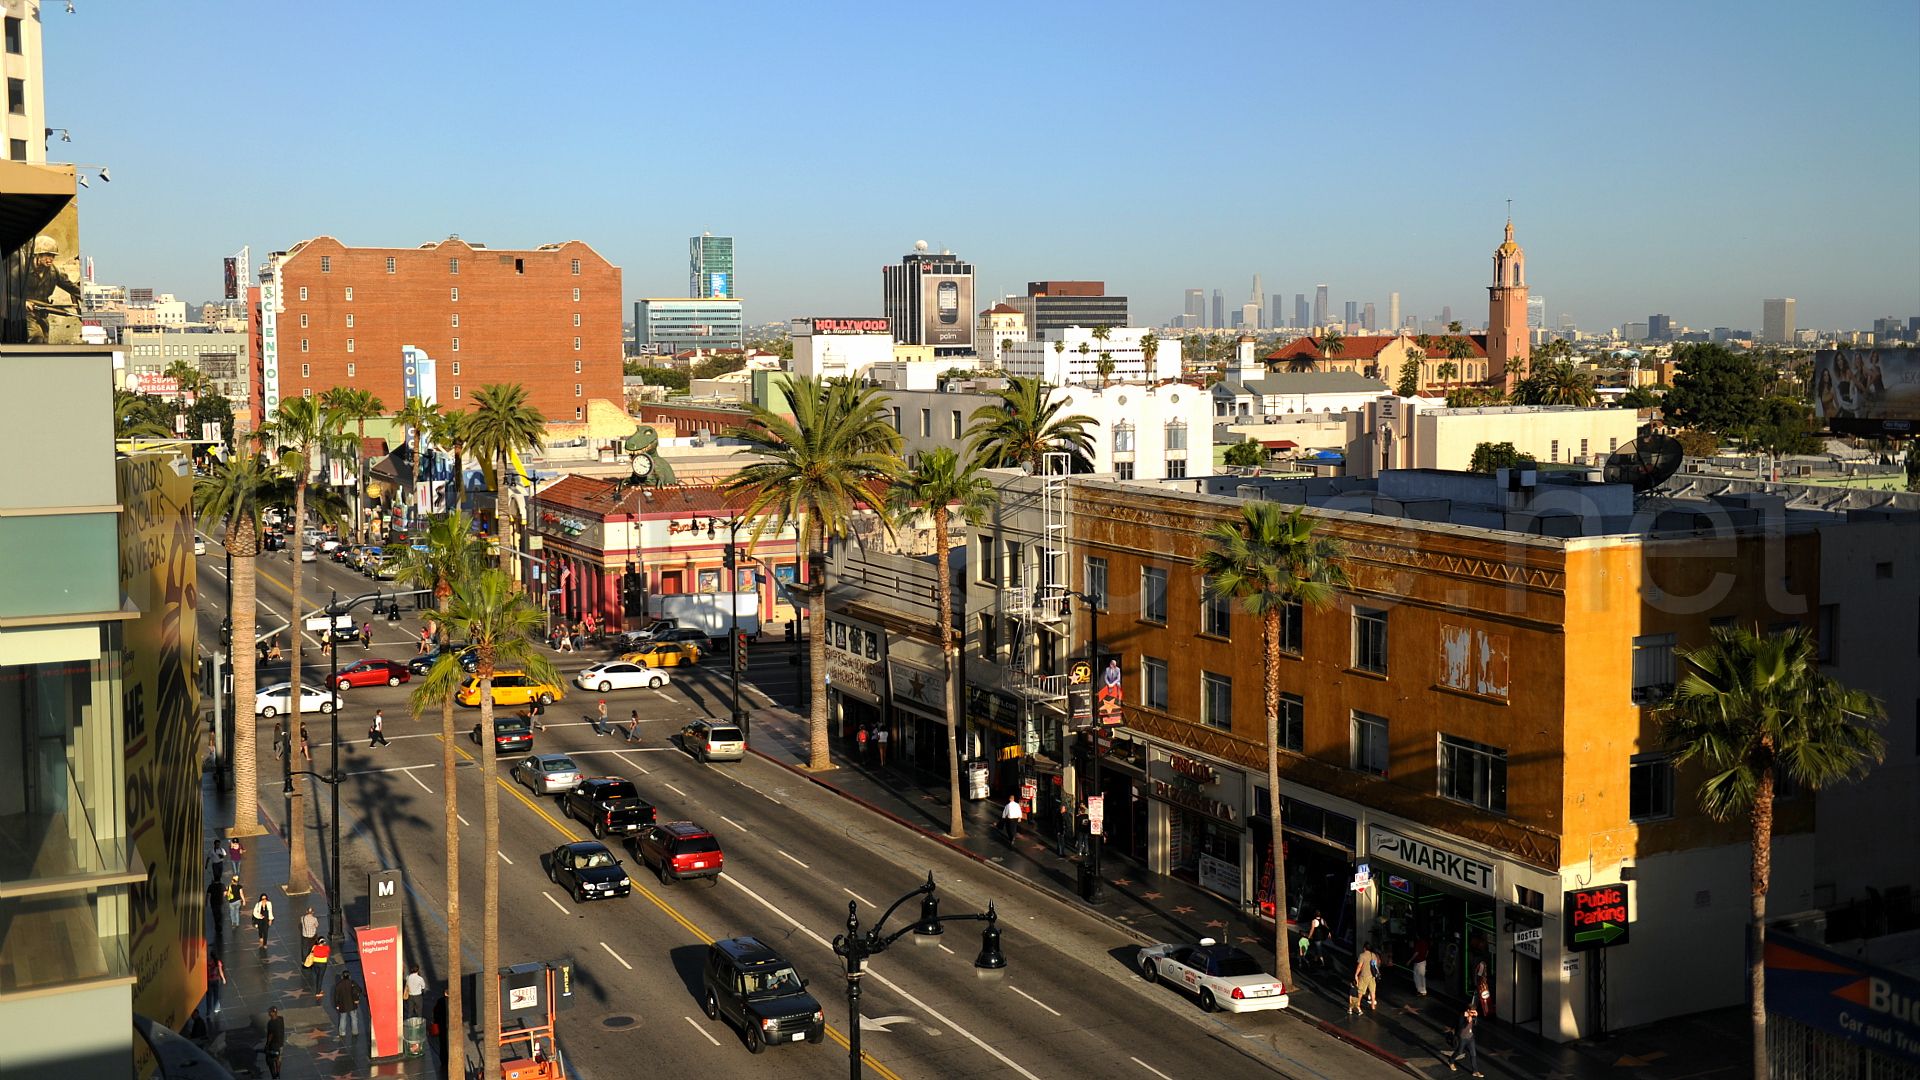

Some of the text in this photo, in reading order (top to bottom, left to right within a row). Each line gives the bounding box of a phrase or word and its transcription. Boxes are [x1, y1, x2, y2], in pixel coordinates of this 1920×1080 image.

[815, 319, 888, 331] HOLLYWOOD
[939, 331, 957, 342] palm
[264, 286, 278, 418] SCIENTOLOG
[121, 457, 163, 499] WORLD'S
[121, 494, 165, 539] USICAL IS
[120, 533, 165, 583] AS VEGAS
[1076, 666, 1091, 683] 50
[124, 681, 145, 746] HE
[1399, 838, 1492, 889] MARKET
[378, 880, 394, 897] M
[1576, 888, 1621, 909] Public
[1574, 906, 1626, 926] Parking
[1516, 930, 1538, 942] HOSTEL
[362, 945, 389, 954] Highland
[1839, 1011, 1920, 1055] Car and Tru
